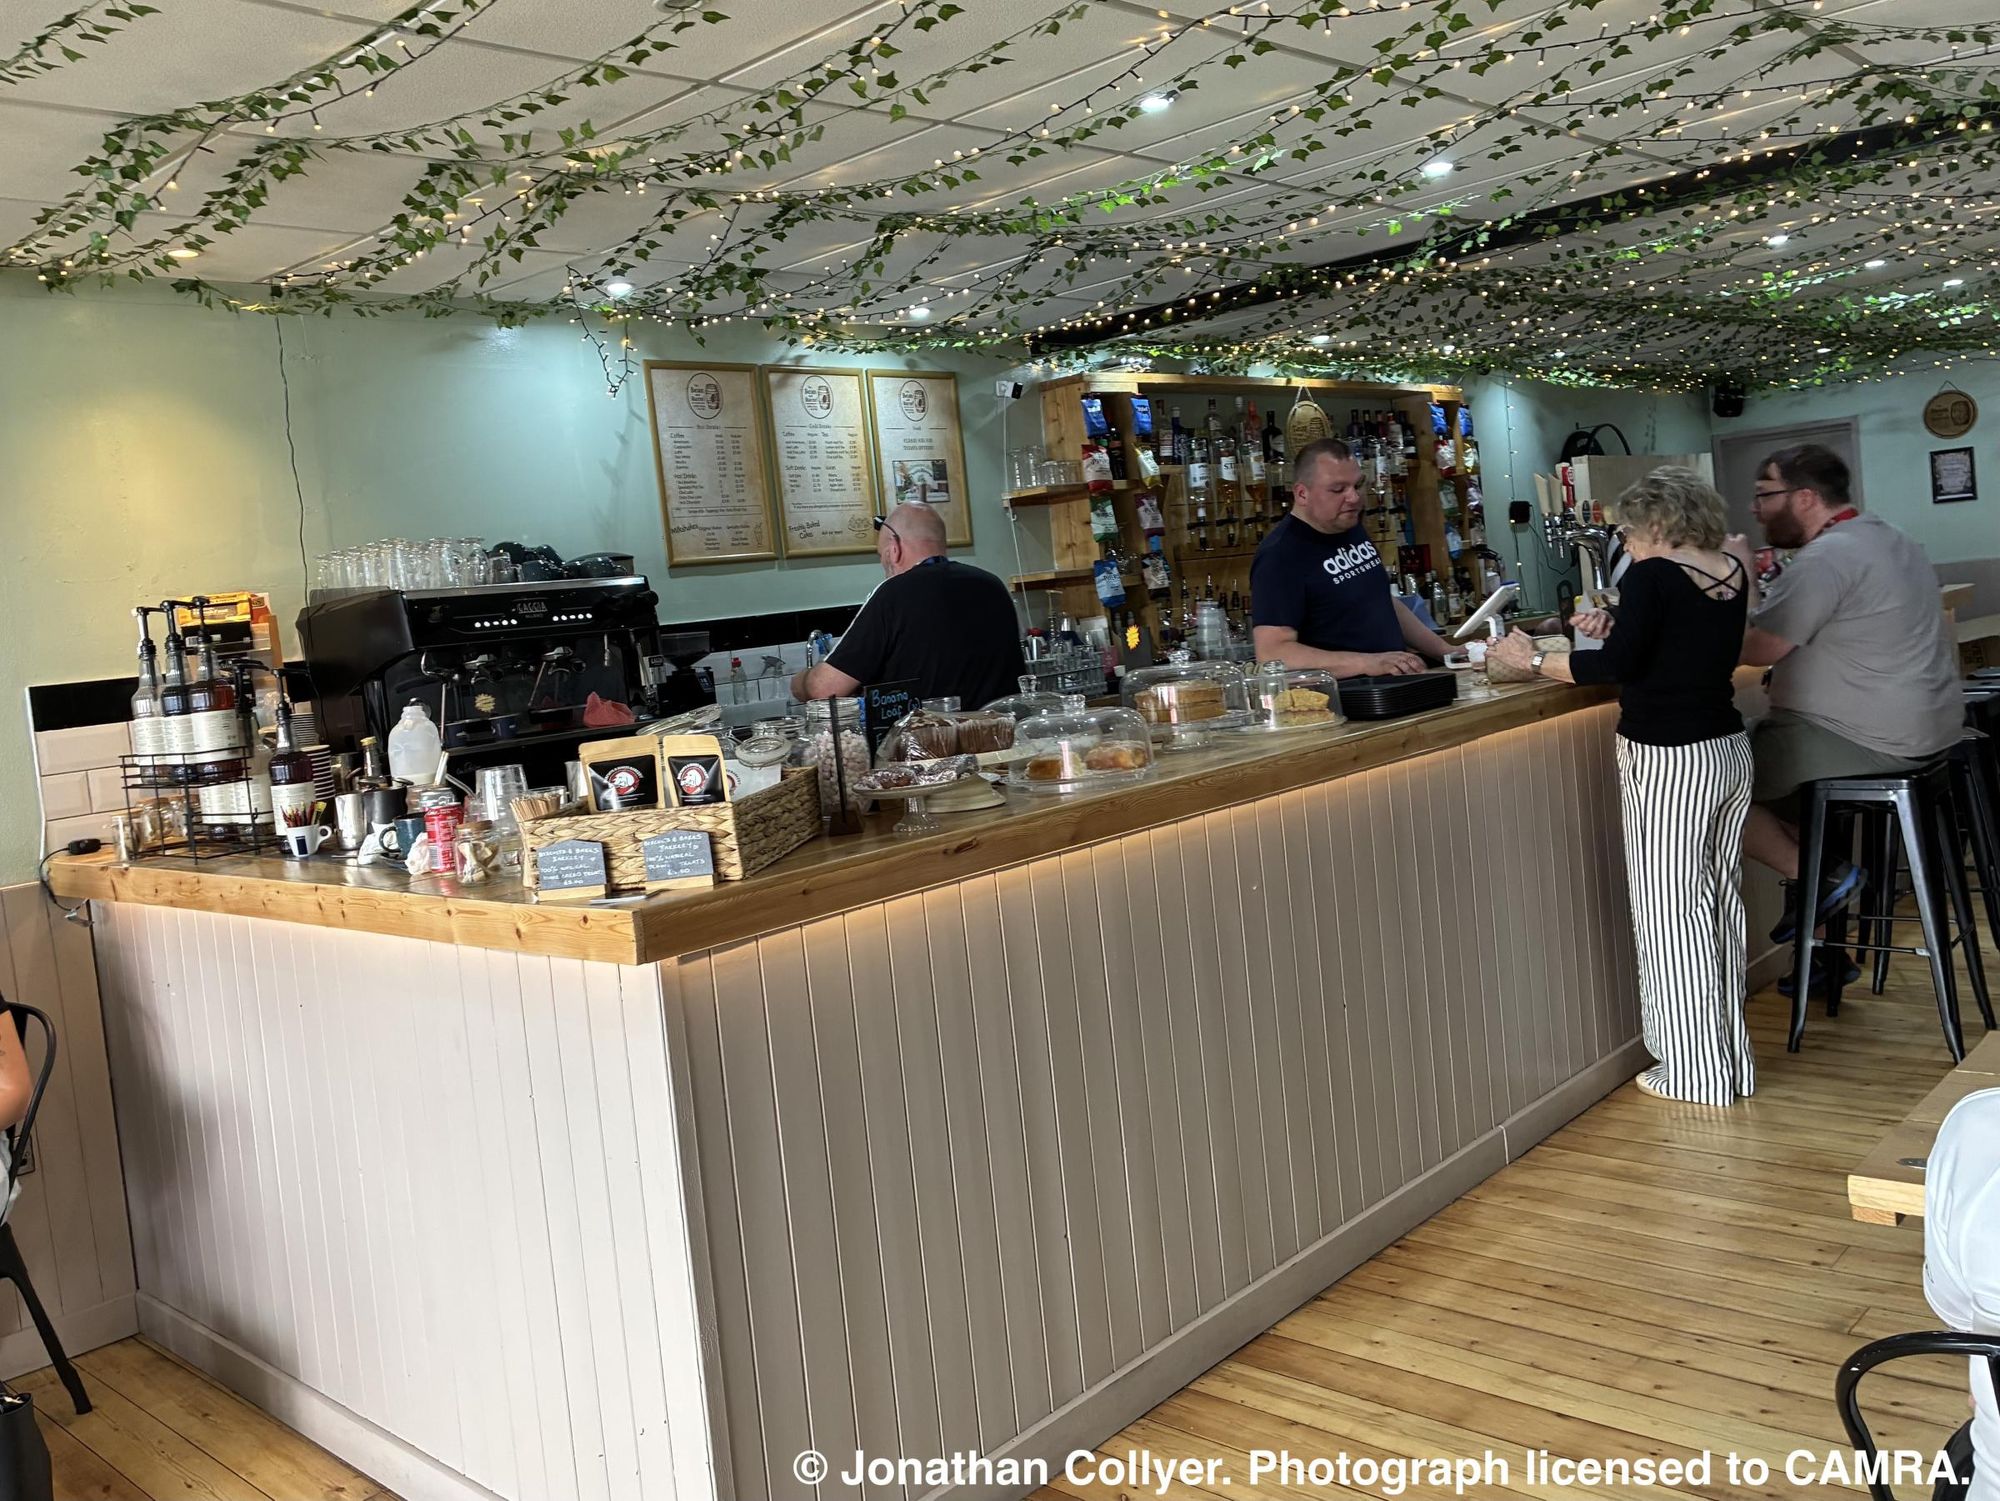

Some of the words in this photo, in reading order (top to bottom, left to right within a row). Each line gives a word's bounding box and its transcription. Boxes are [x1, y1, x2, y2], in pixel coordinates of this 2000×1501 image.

[1323, 541, 1377, 575] adidas
[871, 689, 909, 707] Banana
[881, 705, 903, 720] Loaf
